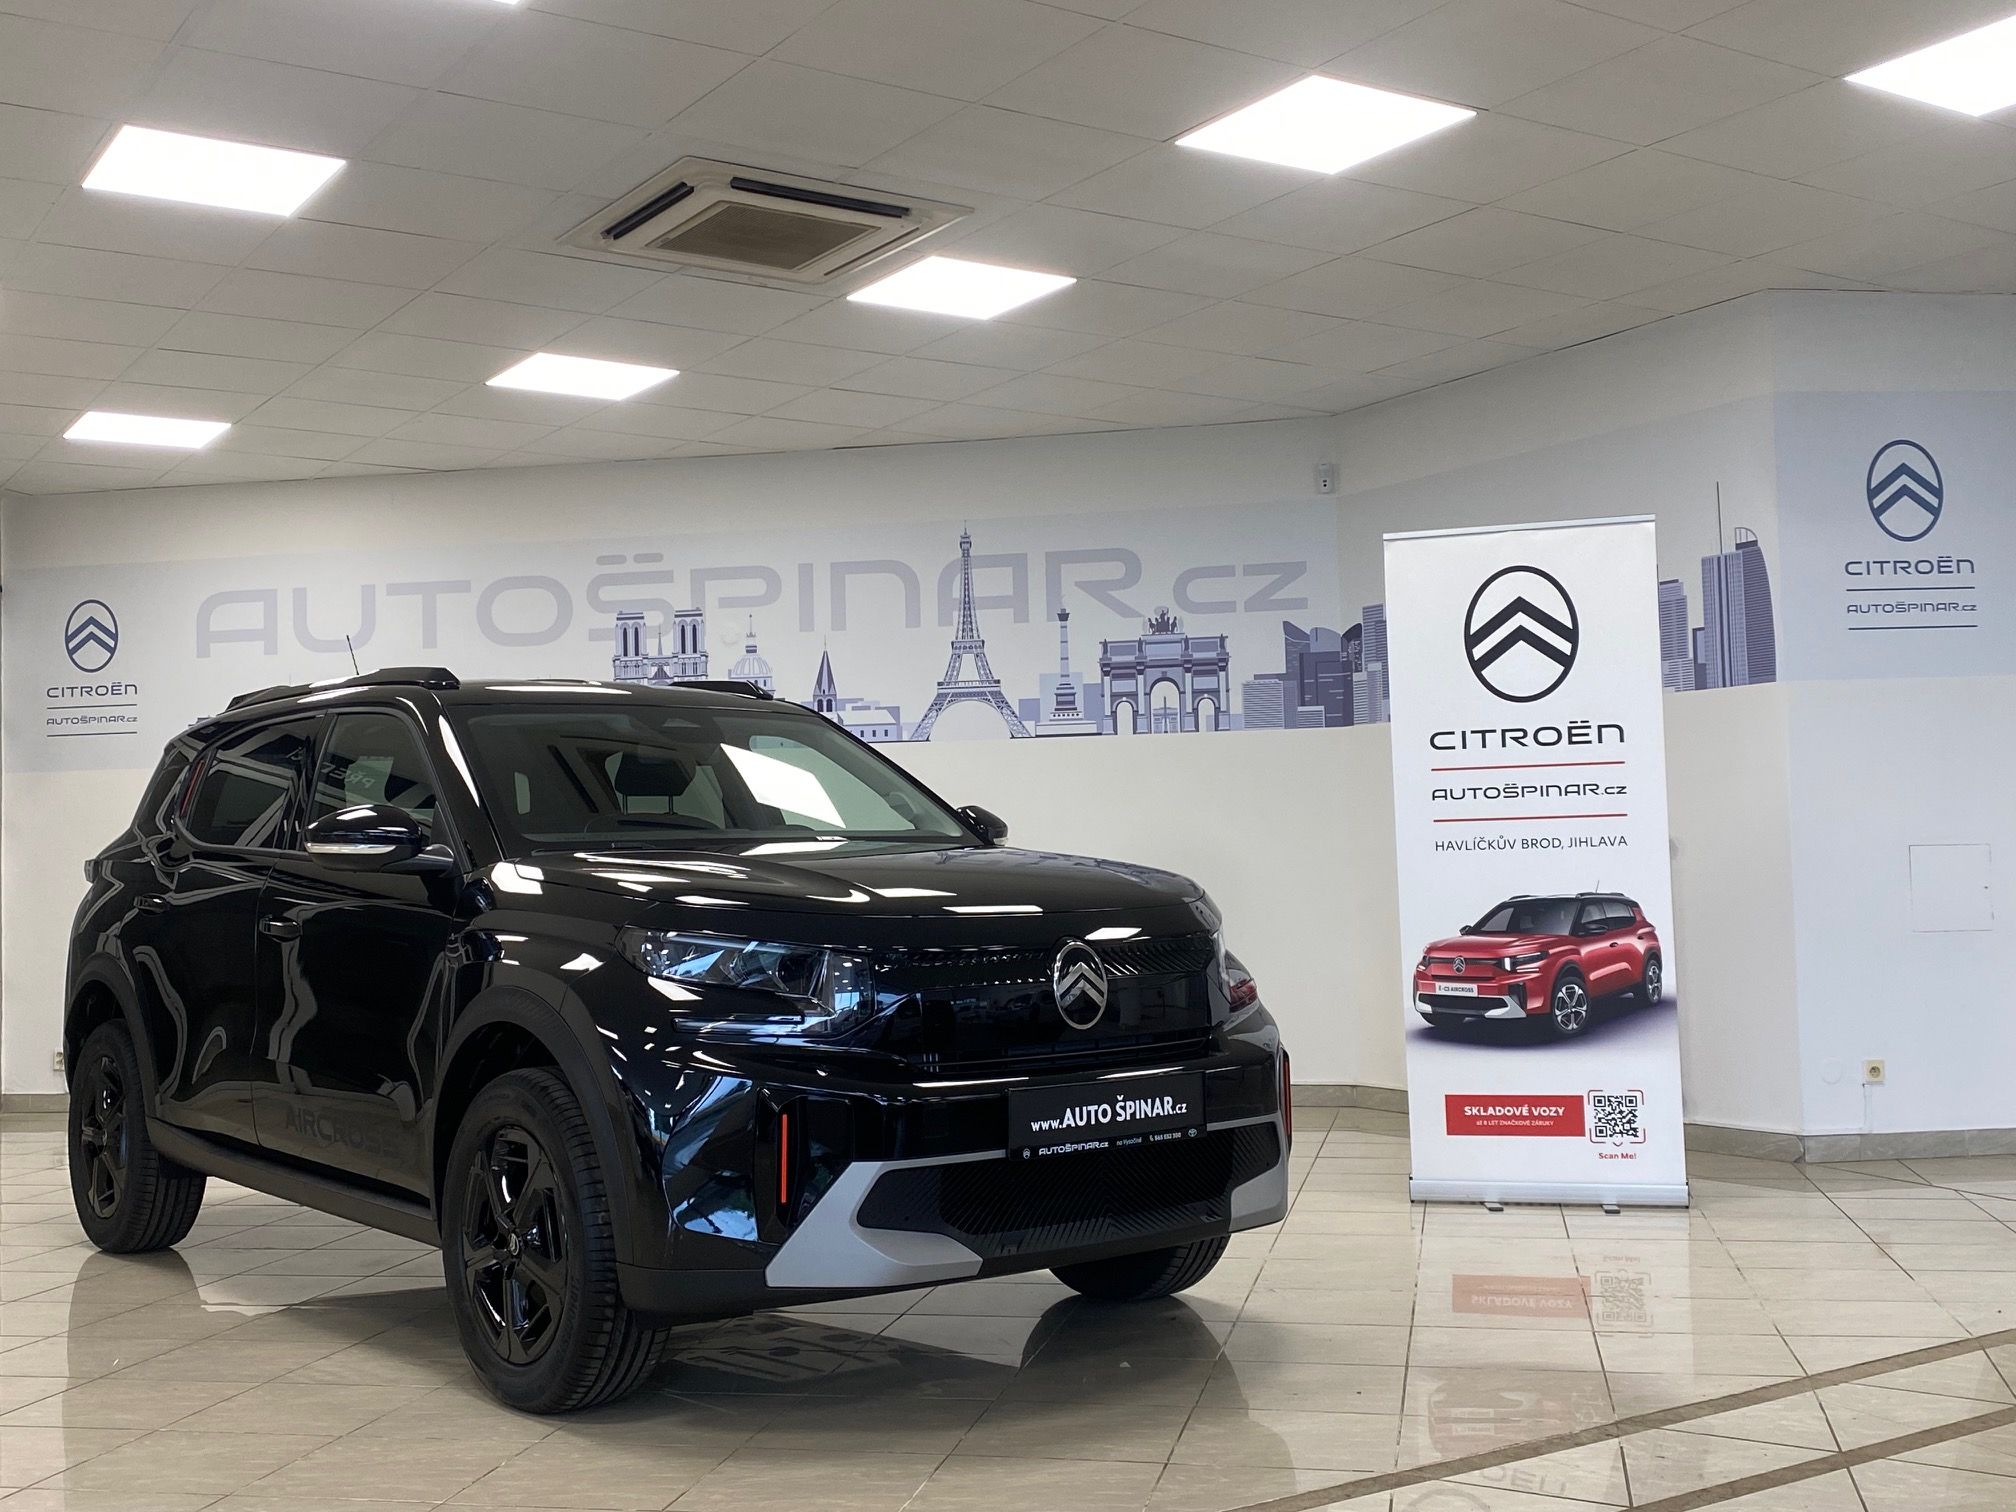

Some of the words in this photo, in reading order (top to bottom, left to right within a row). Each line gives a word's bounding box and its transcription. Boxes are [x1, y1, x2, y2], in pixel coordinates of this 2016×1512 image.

[1844, 556, 1975, 576] CITROËN
[46, 681, 138, 699] CITROËN
[1428, 720, 1626, 751] CITROËN
[1434, 834, 1517, 852] HAVLÍČKŮV
[1521, 837, 1564, 850] BROD,
[1567, 835, 1628, 849] JIHLAVA
[1030, 1103, 1112, 1132] www.AUTO
[1116, 1094, 1188, 1122] ŠPINAR.cz
[1464, 1103, 1530, 1116] SKLADOVÉ
[1530, 1105, 1566, 1117] VOZY
[1598, 1152, 1619, 1160] Scan
[1621, 1152, 1637, 1160] Me!
